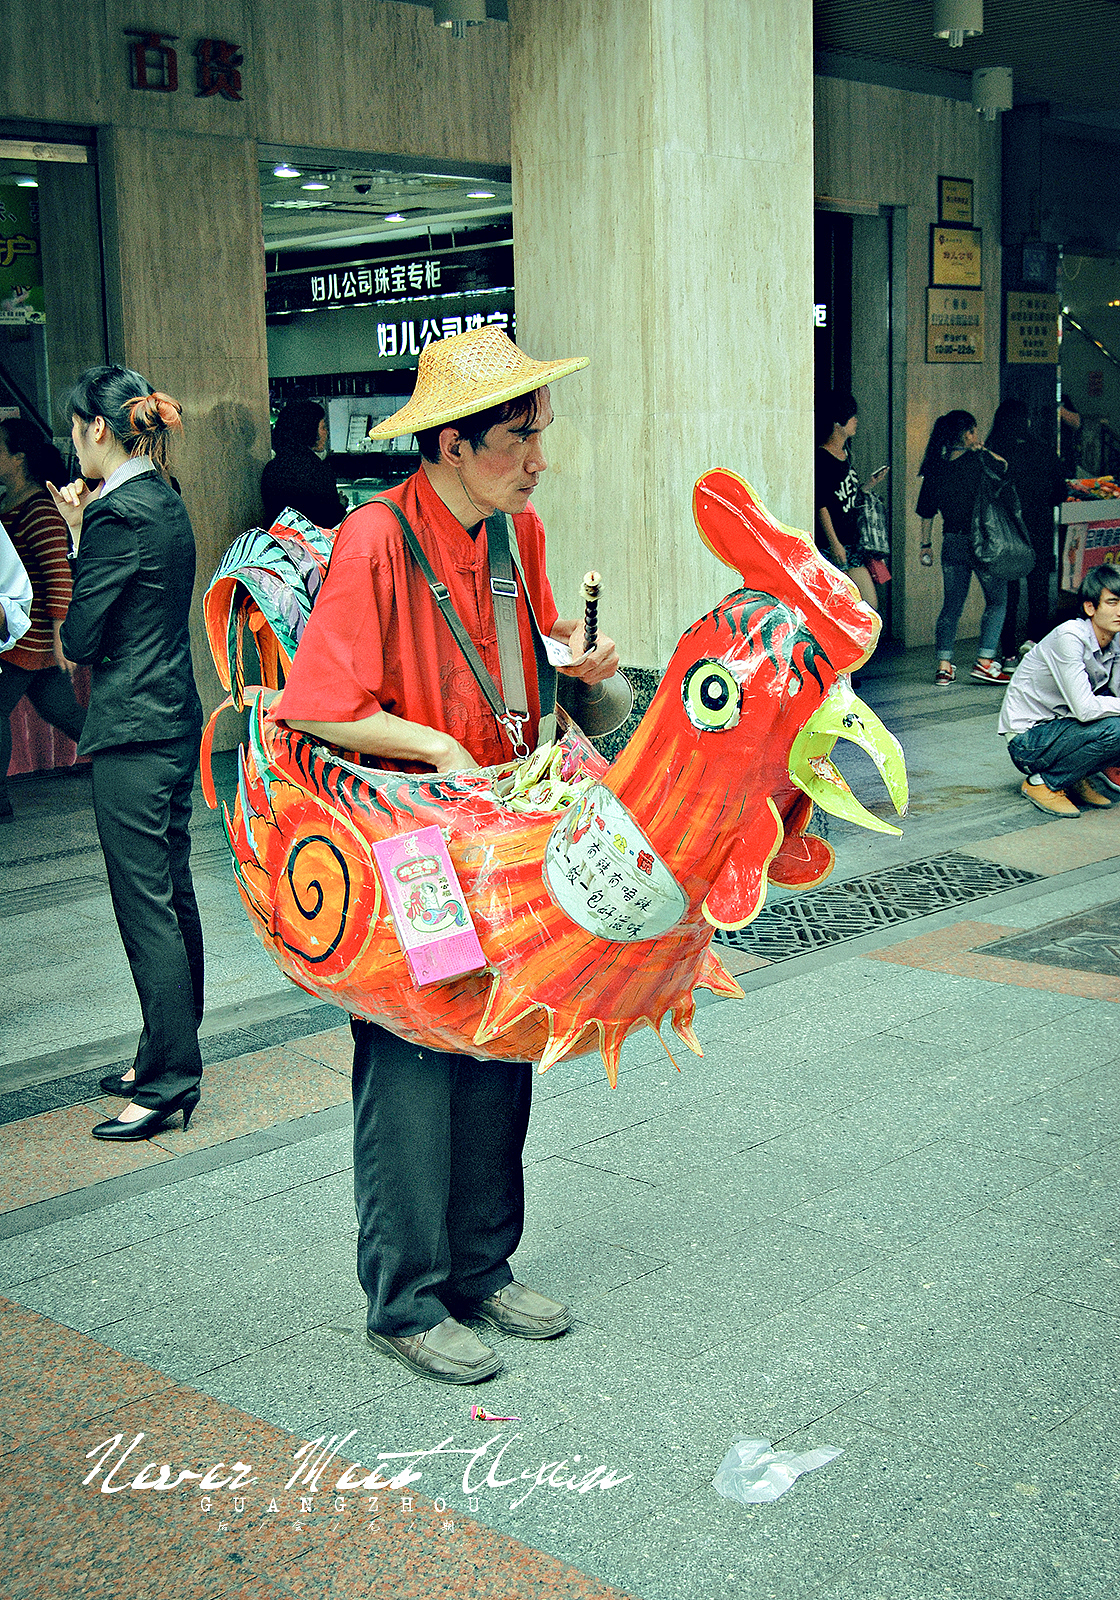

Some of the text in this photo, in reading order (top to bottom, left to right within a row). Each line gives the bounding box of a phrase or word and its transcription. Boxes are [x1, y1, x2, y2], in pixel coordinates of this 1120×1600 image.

[123, 28, 245, 101] 百货
[311, 261, 442, 302] 妇儿公司珠宝专柜
